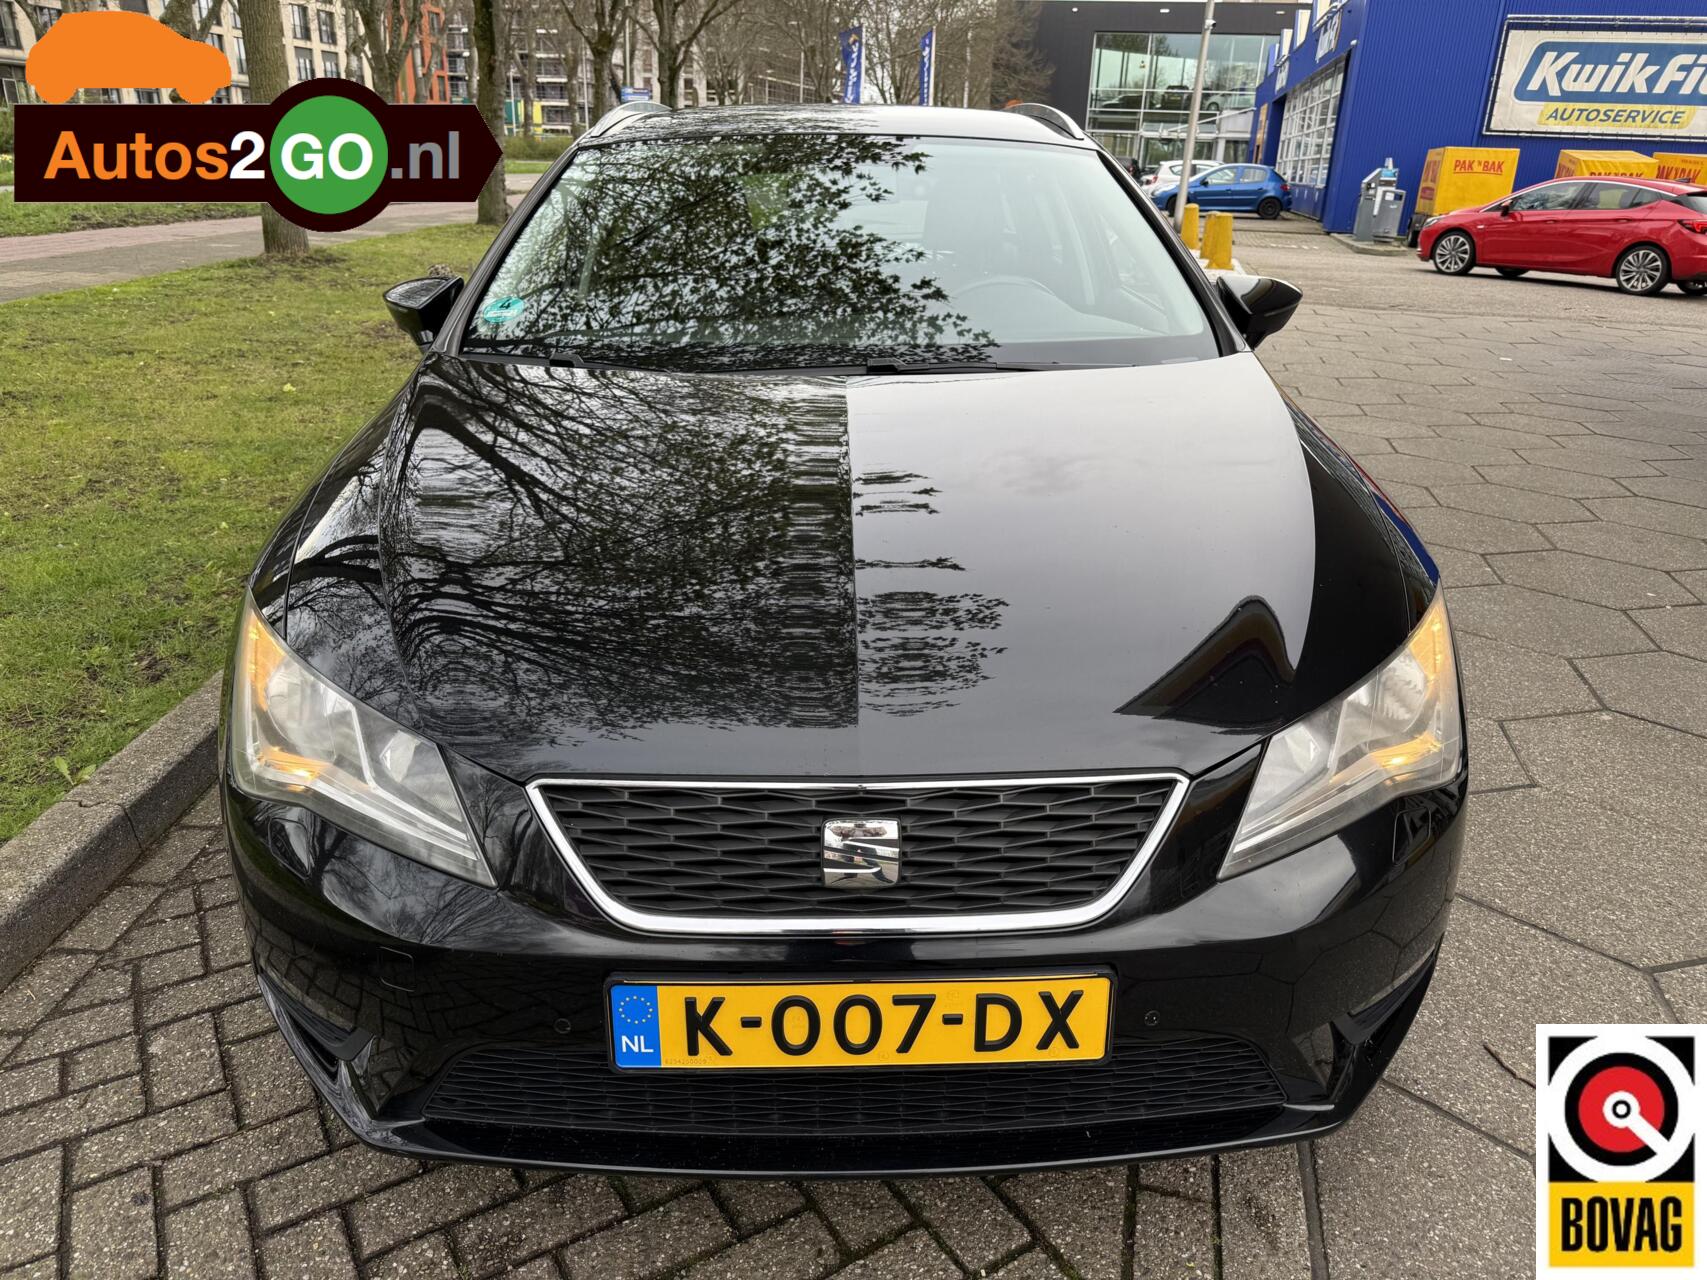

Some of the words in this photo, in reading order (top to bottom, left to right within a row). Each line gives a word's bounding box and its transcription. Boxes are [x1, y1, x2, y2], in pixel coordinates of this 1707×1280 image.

[1546, 107, 1686, 125] AUTOSERVICE
[1453, 159, 1475, 172] PAK
[1482, 160, 1505, 173] BAK
[684, 989, 1085, 1056] K-007-DX
[621, 1035, 654, 1053] NL
